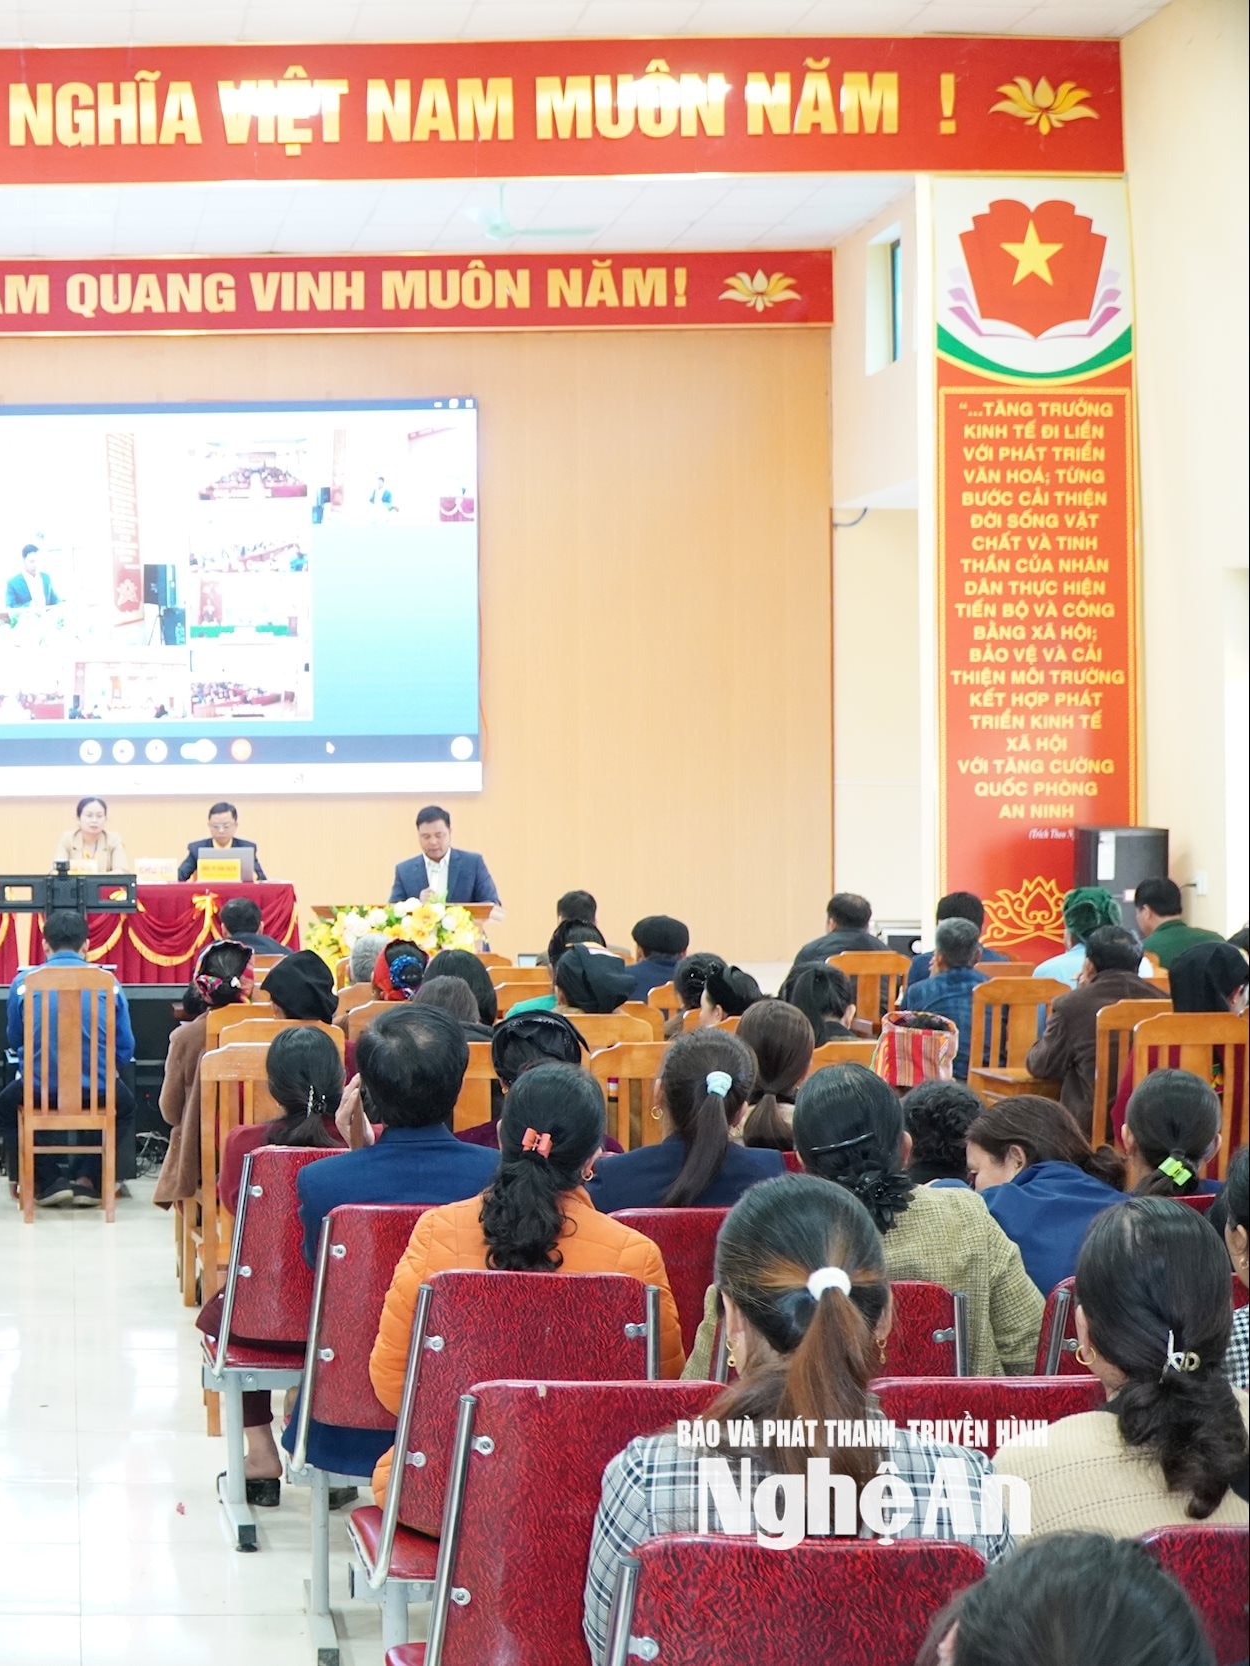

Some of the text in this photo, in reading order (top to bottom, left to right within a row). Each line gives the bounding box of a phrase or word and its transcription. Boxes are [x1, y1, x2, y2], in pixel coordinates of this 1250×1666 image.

[9, 69, 203, 147] NGHĨA
[217, 65, 349, 156] VIỆT
[366, 78, 514, 142] NAM
[535, 59, 725, 139] MUÔN
[746, 57, 899, 135] NĂM
[66, 273, 237, 318] QUANG
[249, 271, 366, 311] VINH
[381, 259, 531, 310] MUÔN
[964, 424, 1007, 439] KINH
[1013, 420, 1036, 439] TẾ
[1041, 424, 1059, 439] ĐI
[963, 444, 993, 461] VỚI
[999, 444, 1047, 461] PHÁT
[964, 467, 1001, 483] VĂN
[962, 487, 1107, 508] BƯỚC CẢI THIỆN
[1007, 508, 1059, 528] SỐNG
[1064, 511, 1099, 530] VẬT
[972, 531, 1097, 551] CHẤT VÀ TINH
[1015, 554, 1054, 573] CỦA
[1059, 555, 1109, 572] NHÂN
[965, 577, 1105, 597] DÂN THỰC HIỆN
[955, 598, 1115, 620] TIẾN BỘ VÀ CÔNG
[1032, 622, 1056, 640] XÃ
[970, 643, 1102, 665] BẢO VỆ VÀ CẢI
[950, 667, 1005, 687] THIỆN
[1011, 667, 1044, 684] MÔI
[970, 687, 1102, 709] KẾT HỢP PHÁT
[1031, 715, 1074, 729] KINH
[1079, 710, 1102, 729] TẾ
[1006, 734, 1067, 753] XÃ HỘI
[958, 756, 988, 774] VỚI
[993, 757, 1043, 773] TĂNG
[975, 777, 1098, 796] QUỐC PHÒNG
[999, 804, 1075, 818] AN NINH
